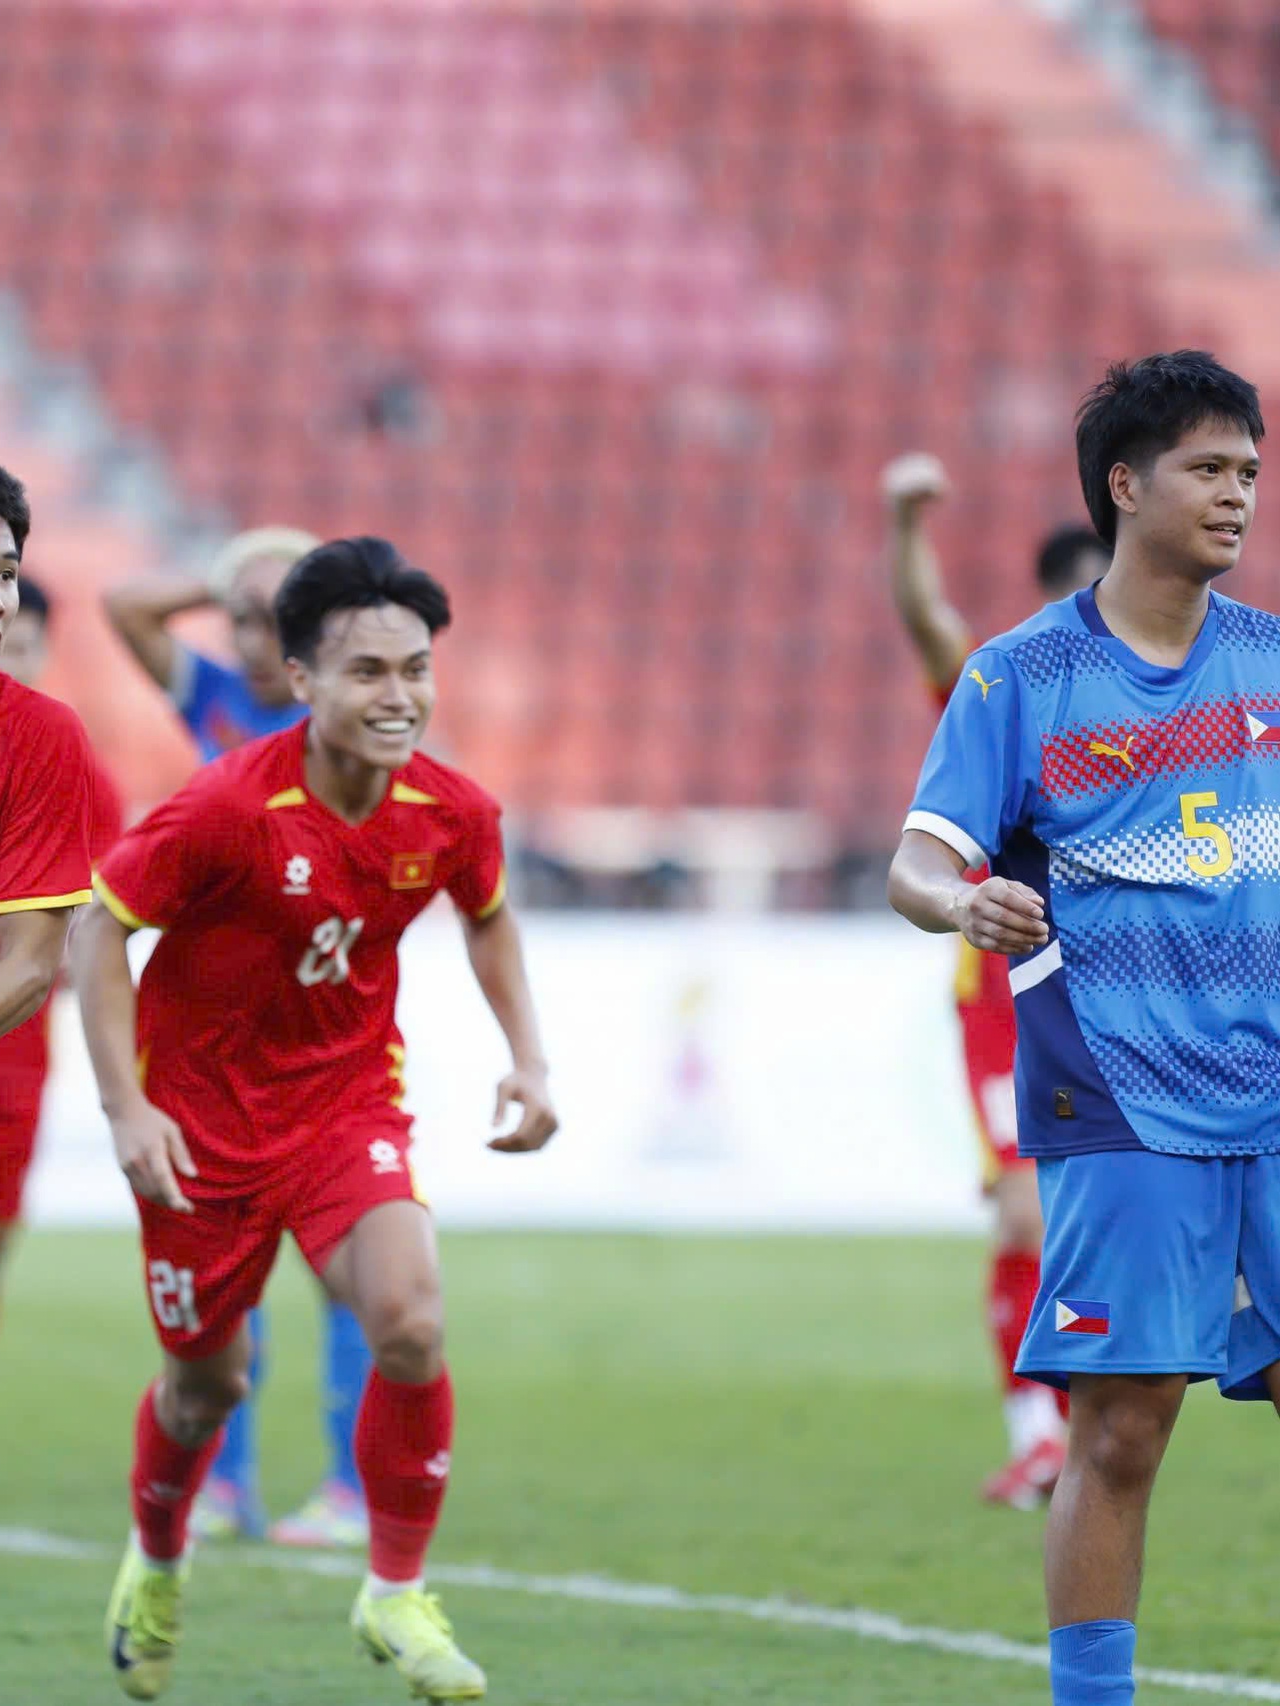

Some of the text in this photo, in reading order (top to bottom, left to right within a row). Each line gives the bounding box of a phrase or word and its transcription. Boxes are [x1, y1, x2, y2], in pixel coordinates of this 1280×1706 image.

[1179, 791, 1234, 878] 5
[296, 915, 365, 987] 21
[150, 1259, 202, 1333] 21
